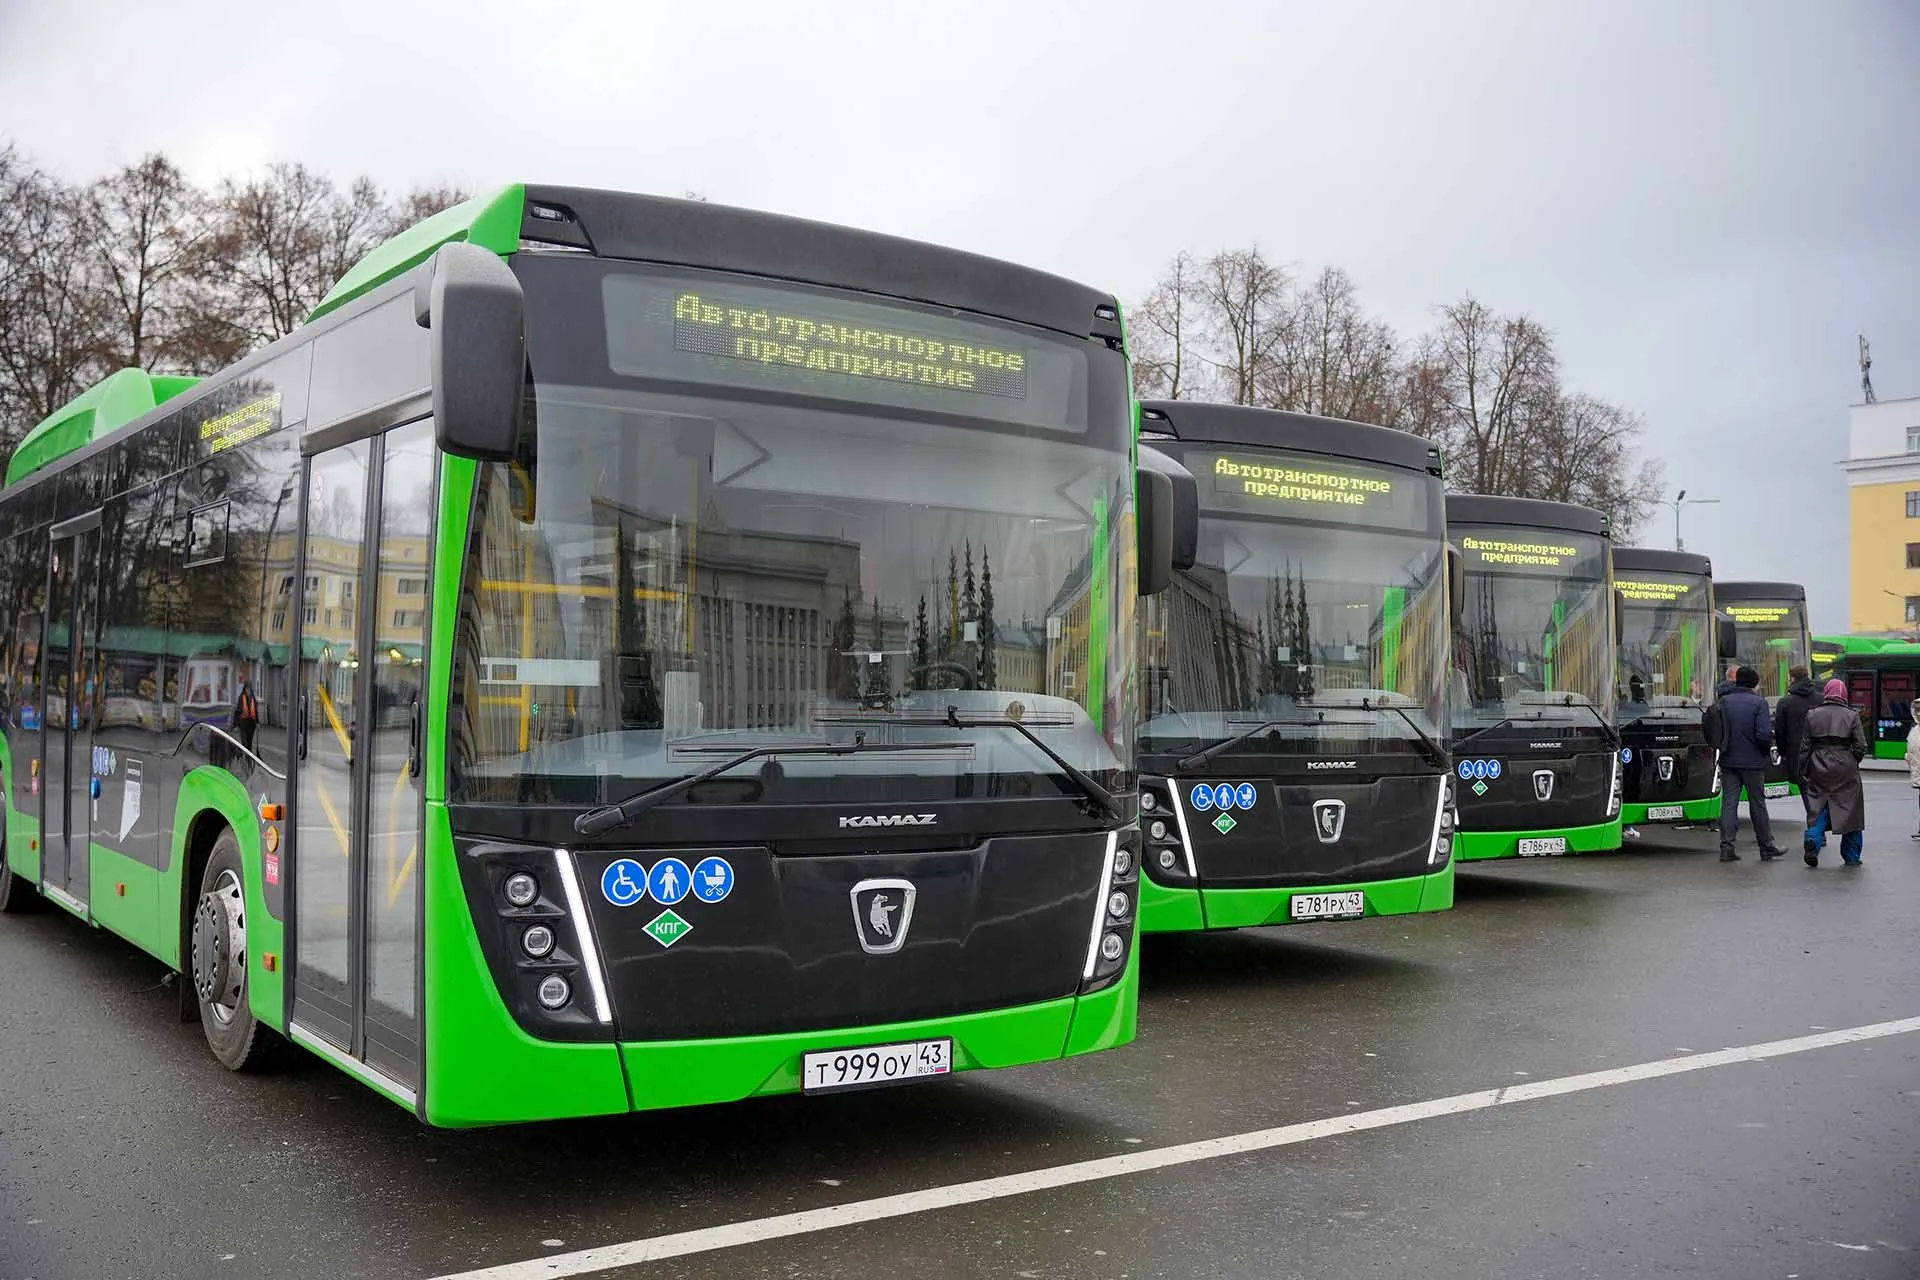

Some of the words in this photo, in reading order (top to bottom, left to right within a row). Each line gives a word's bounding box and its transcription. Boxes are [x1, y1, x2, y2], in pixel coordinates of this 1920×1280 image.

[676, 294, 1024, 371] Автотранспортное
[735, 337, 975, 388] предприятие
[1215, 458, 1391, 493] Автотранспортное
[1244, 480, 1366, 505] предприятие
[1463, 537, 1577, 556] Автотранспортное
[1481, 552, 1560, 566] предприятие
[1613, 581, 1689, 593] тотранспортное
[1307, 761, 1357, 770] KAMAZ
[839, 813, 938, 829] KAMAZ
[1297, 896, 1345, 914] Е781РХ
[1348, 893, 1360, 906] 43
[655, 921, 682, 936] КПГ
[815, 1051, 913, 1085] Т999ОУ
[919, 1043, 942, 1065] 43
[918, 1065, 935, 1075] RUS
